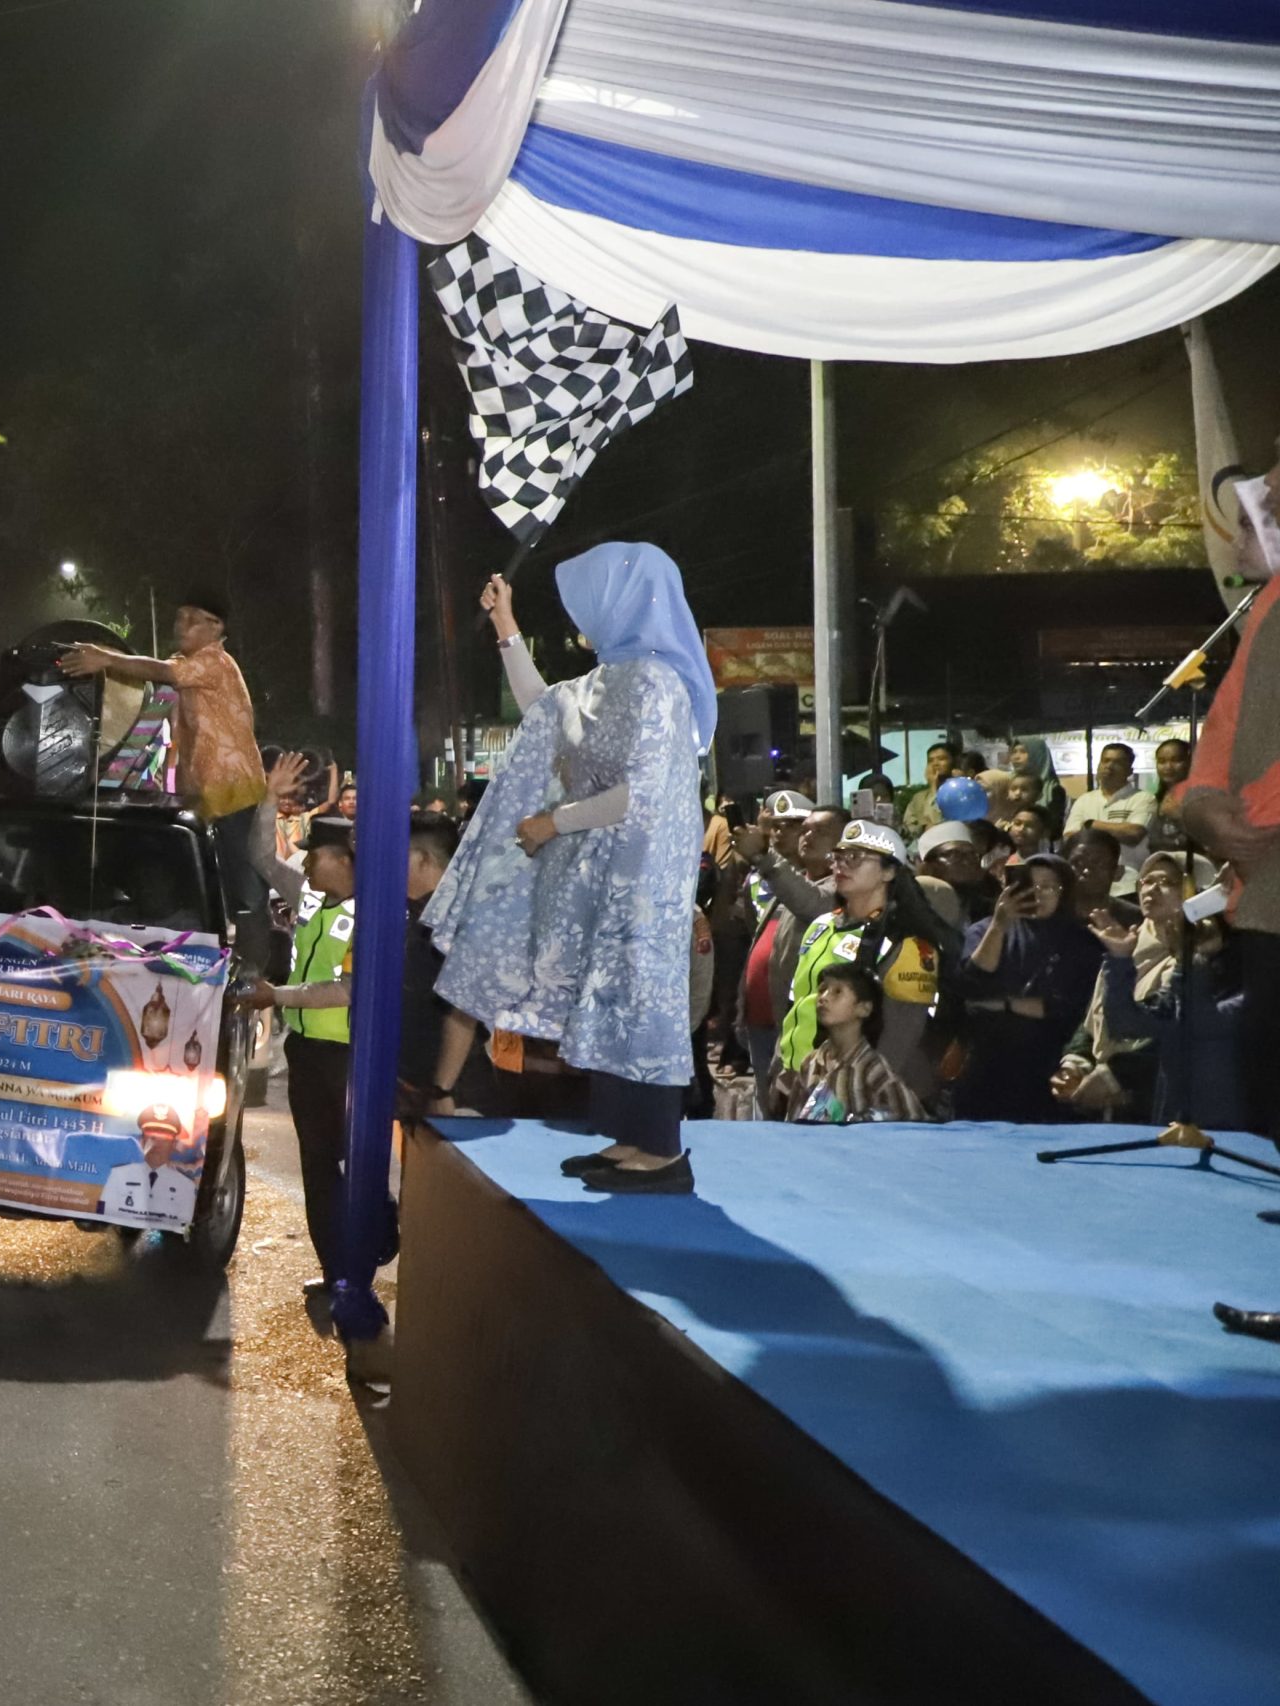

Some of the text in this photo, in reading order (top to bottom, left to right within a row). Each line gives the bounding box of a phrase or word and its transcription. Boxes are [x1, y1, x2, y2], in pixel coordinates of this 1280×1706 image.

[26, 991, 58, 1005] RAYA
[19, 1060, 32, 1071] M
[19, 1110, 49, 1126] Fitri
[53, 1116, 87, 1132] 1445
[91, 1120, 105, 1135] H
[67, 1159, 99, 1175] Malik
